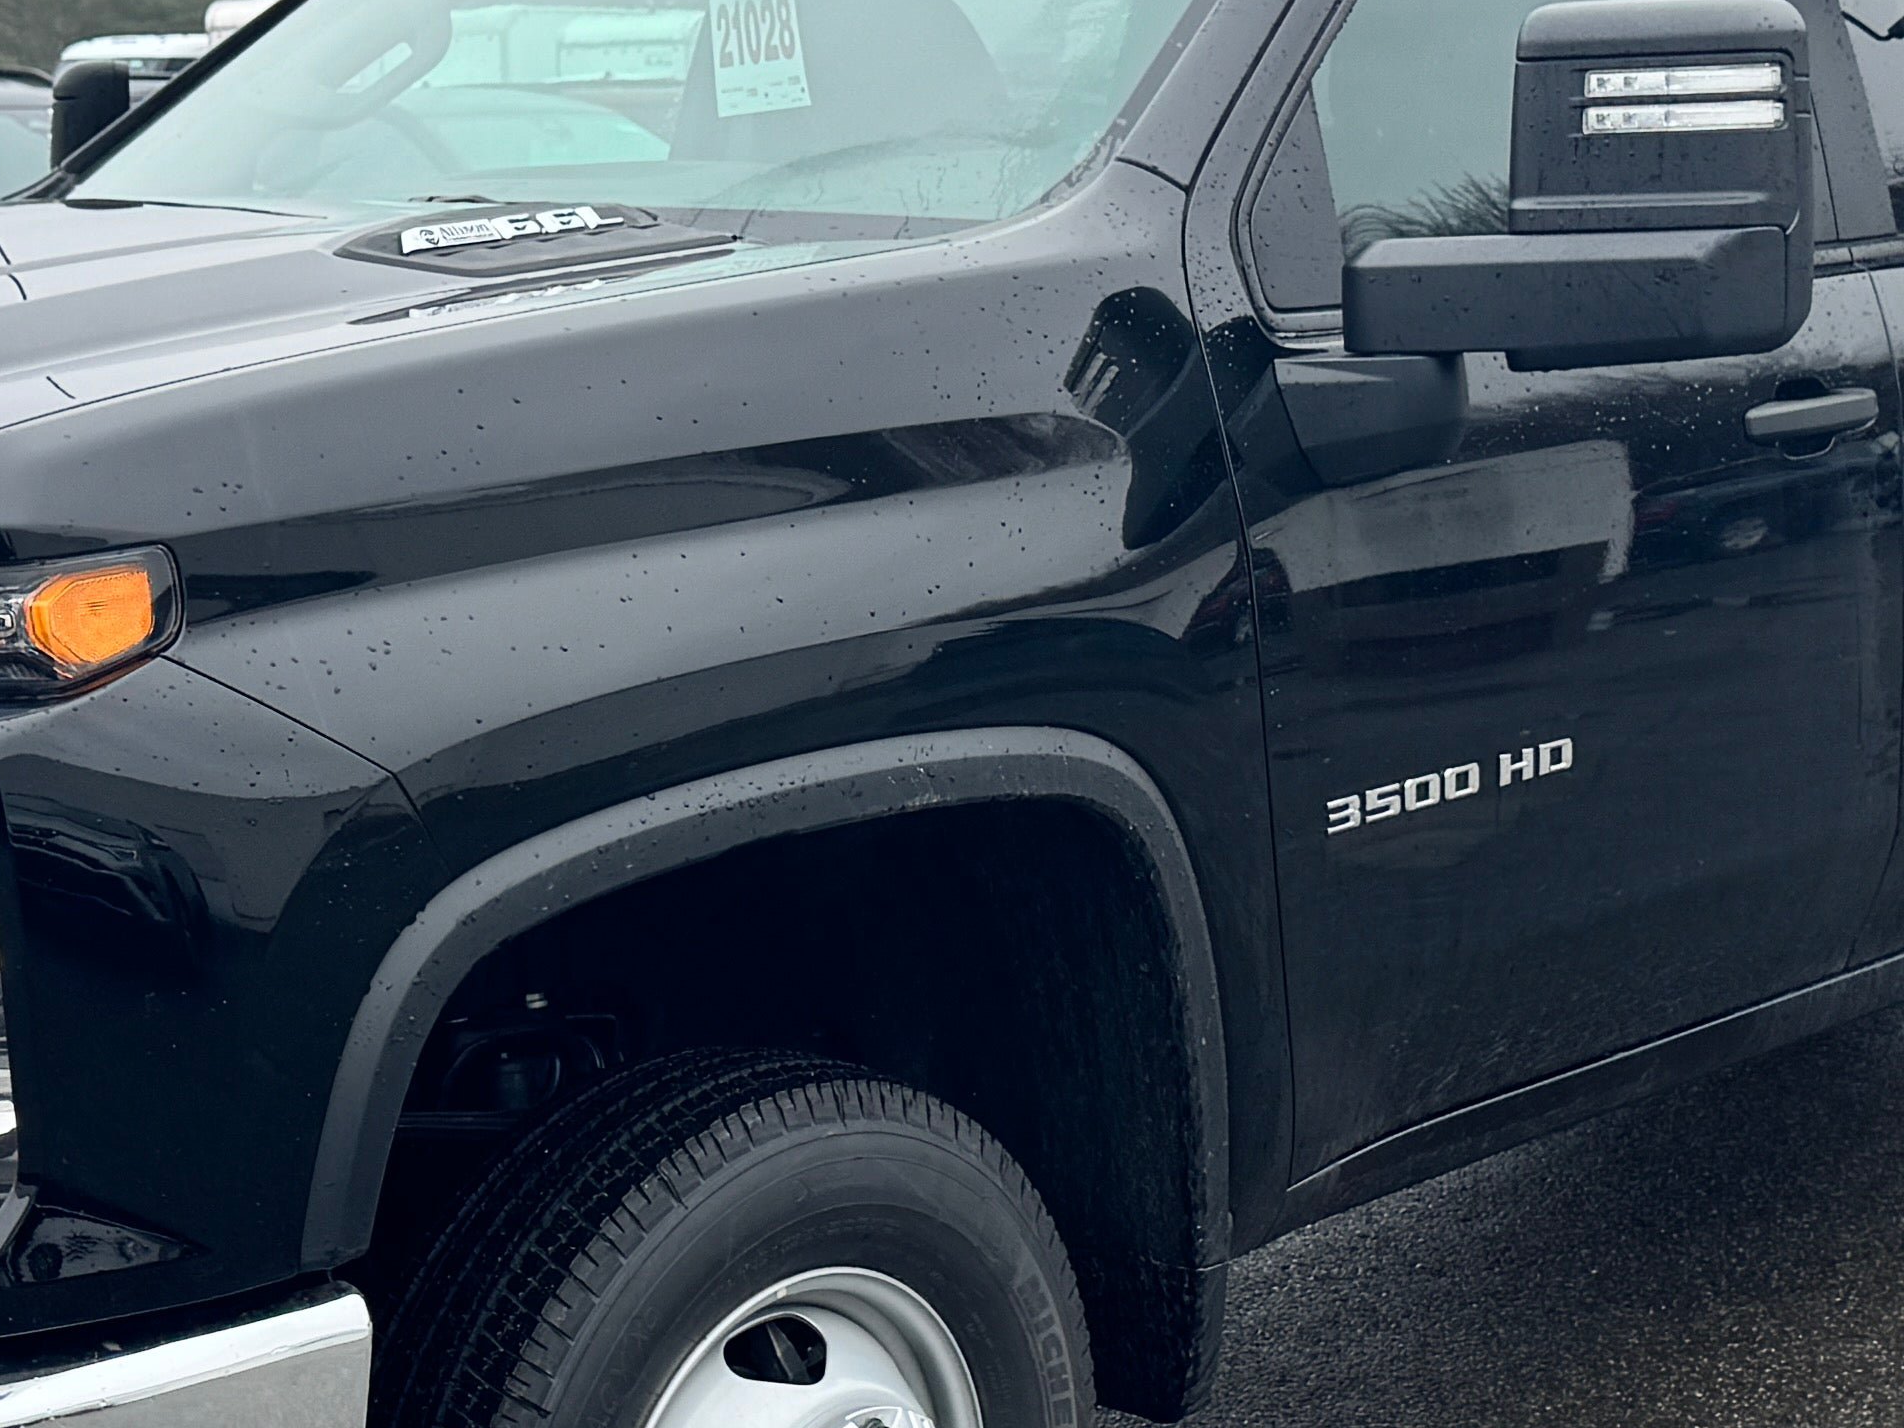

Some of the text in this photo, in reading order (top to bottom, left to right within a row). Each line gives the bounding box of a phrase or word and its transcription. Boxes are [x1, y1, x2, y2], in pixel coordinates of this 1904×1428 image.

[439, 222, 491, 241] Allison
[491, 206, 624, 240] 6.6L
[1326, 737, 1573, 835] 3500 HD
